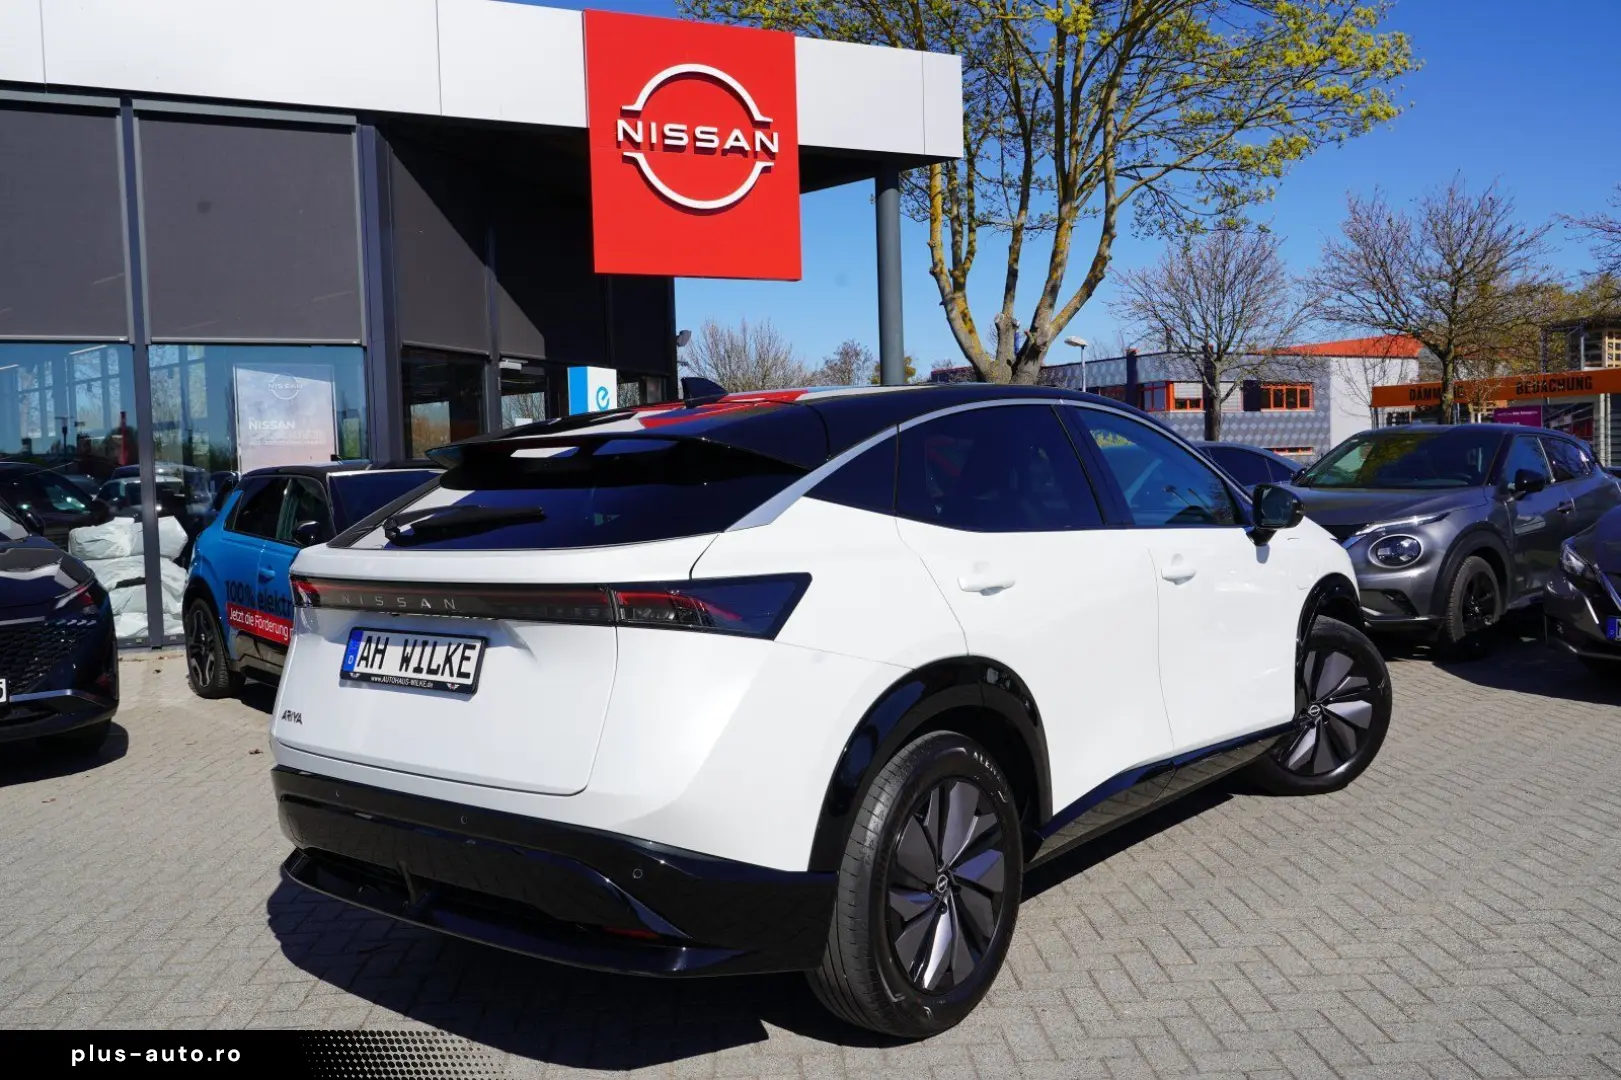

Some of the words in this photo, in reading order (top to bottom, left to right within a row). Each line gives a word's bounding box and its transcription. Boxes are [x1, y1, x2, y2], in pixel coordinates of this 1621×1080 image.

[616, 119, 779, 154] NISSAN
[248, 420, 296, 431] NISSAN
[225, 580, 255, 606] 100%
[341, 595, 456, 610] NISSAN
[230, 608, 245, 624] Jetzt
[245, 612, 254, 626] die
[255, 615, 288, 641] Förderung
[357, 636, 390, 670] AH
[399, 638, 477, 680] WILKE
[281, 709, 303, 725] ARIYA
